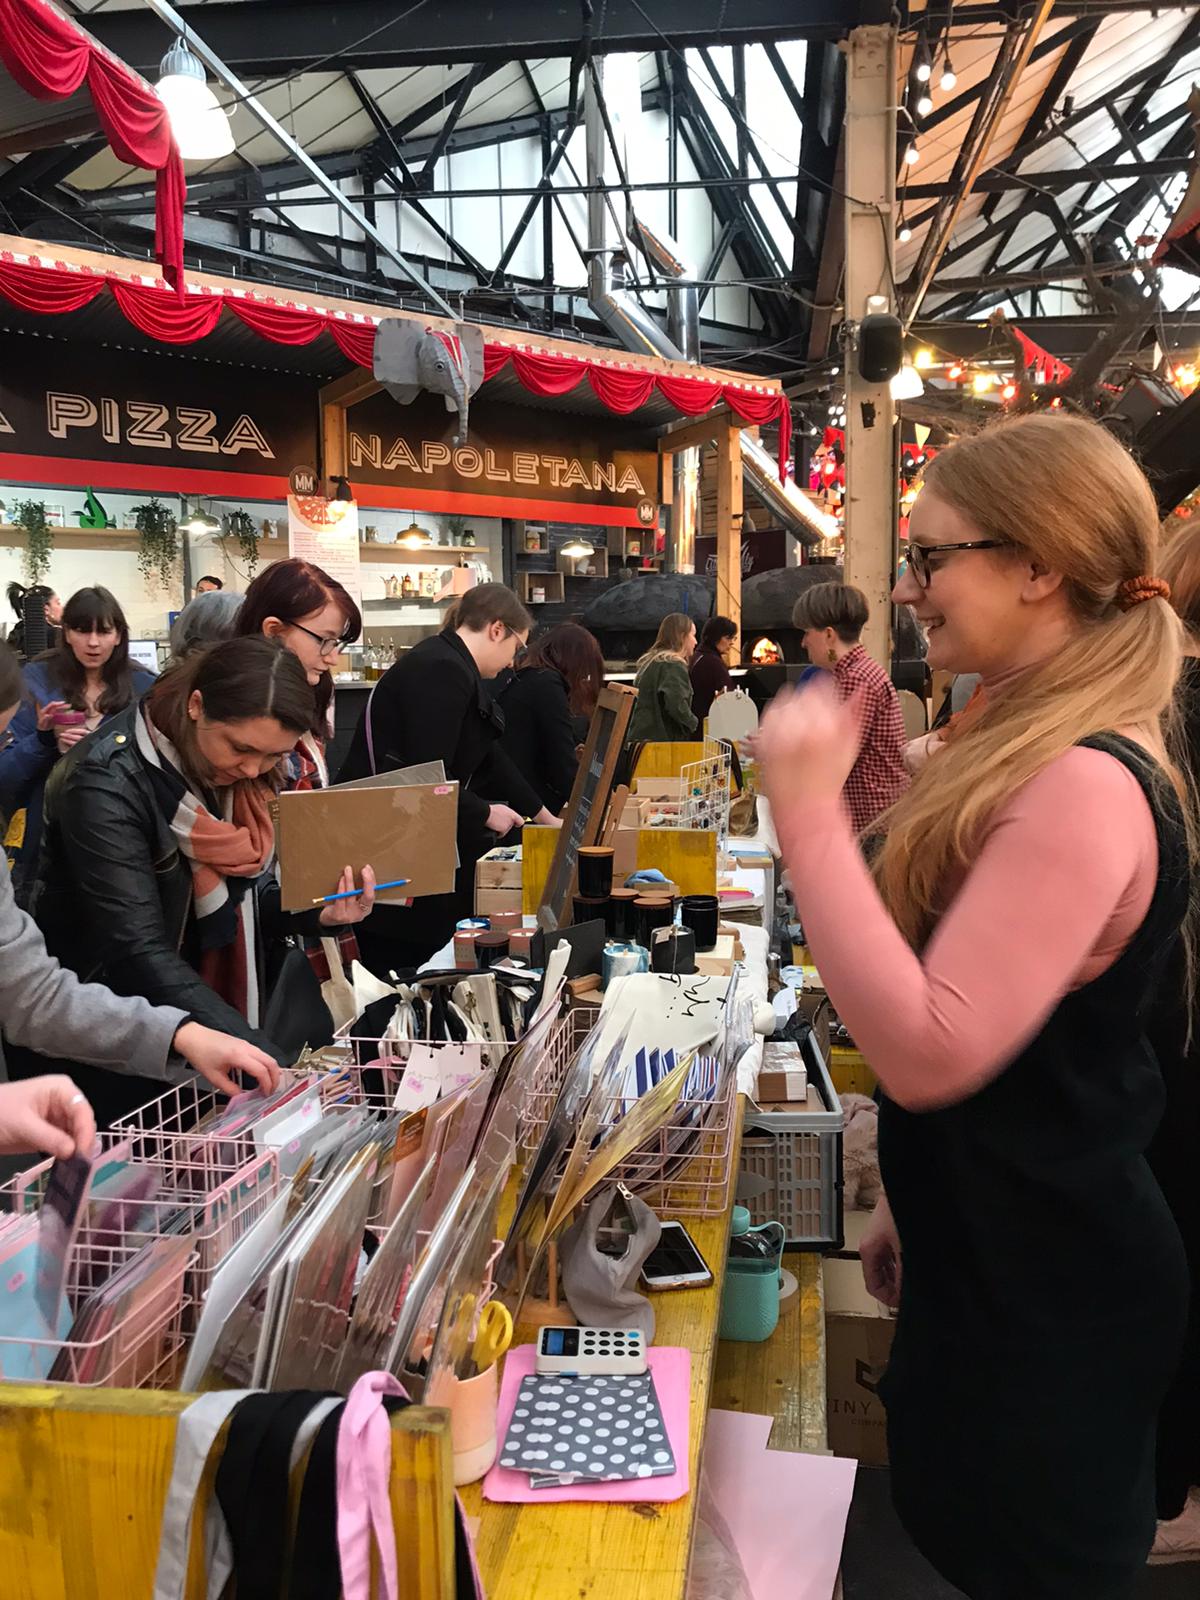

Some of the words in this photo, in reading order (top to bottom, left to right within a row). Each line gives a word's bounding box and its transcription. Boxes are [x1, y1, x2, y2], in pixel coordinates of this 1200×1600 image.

[47, 391, 276, 459] PIZZA
[350, 432, 646, 495] NAPOLETANA
[827, 1399, 872, 1414] INY
